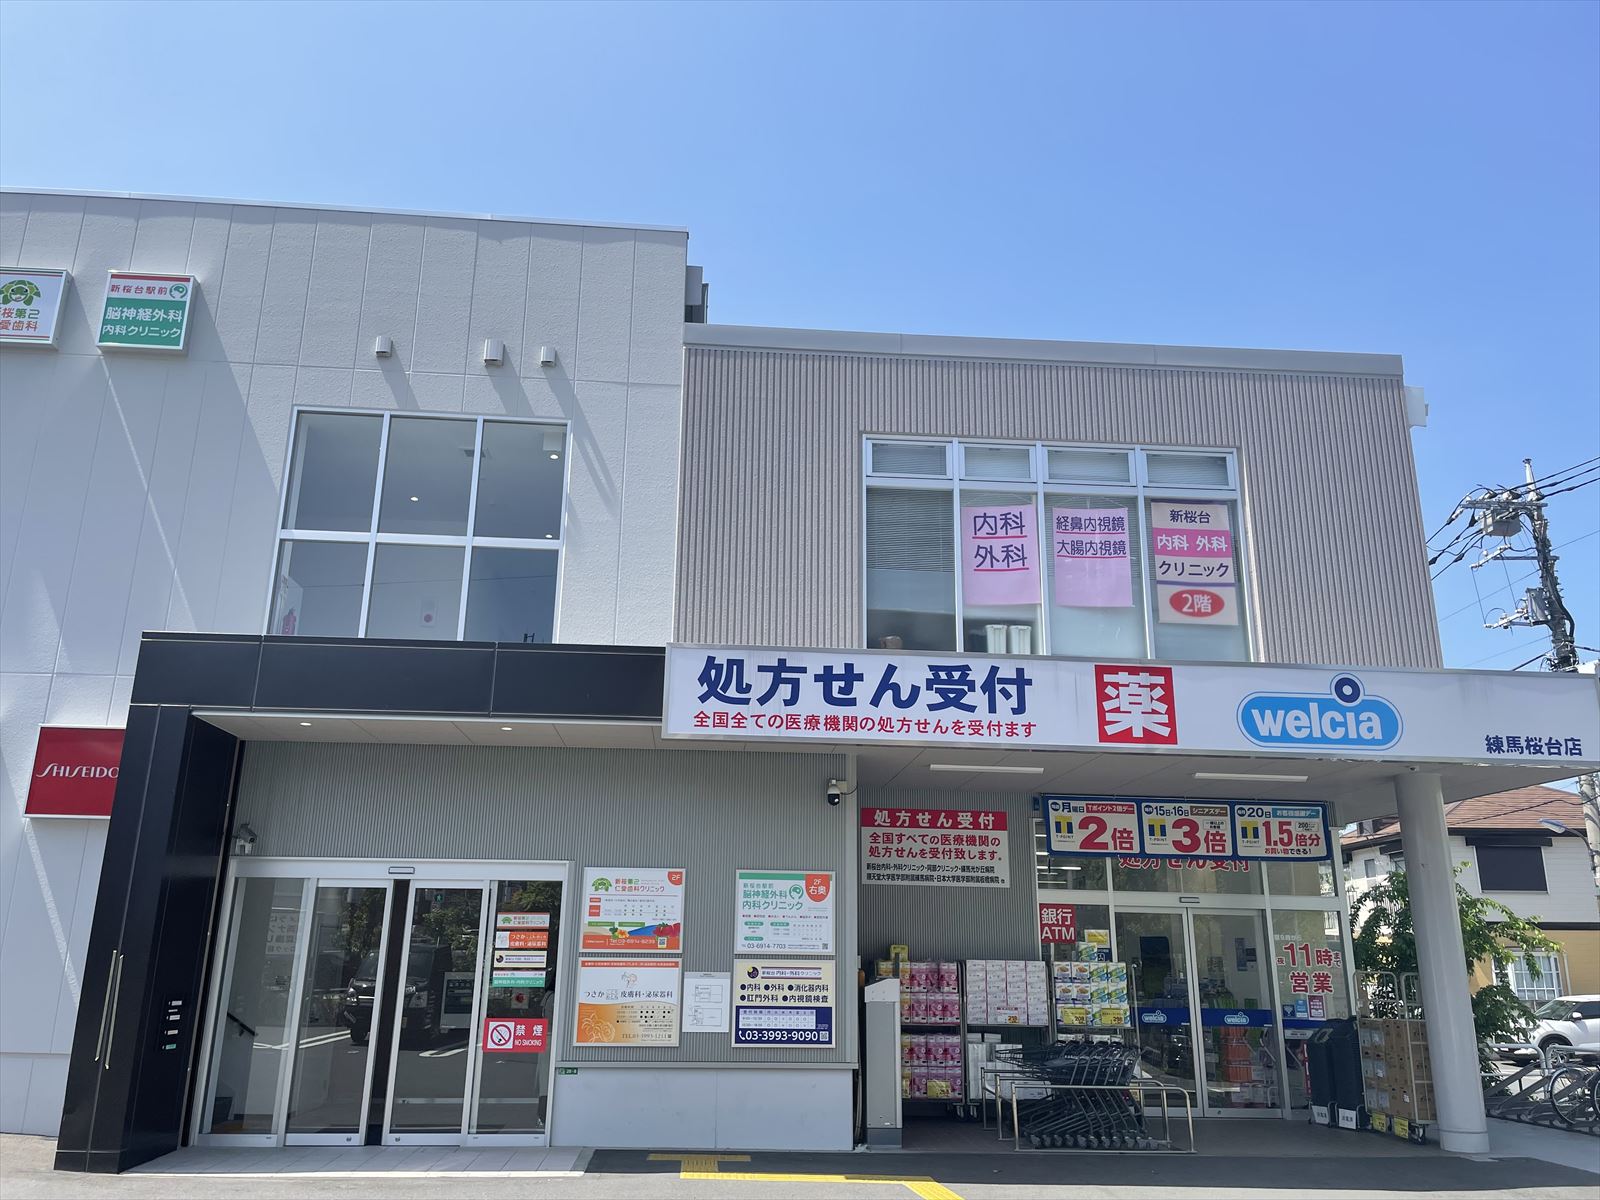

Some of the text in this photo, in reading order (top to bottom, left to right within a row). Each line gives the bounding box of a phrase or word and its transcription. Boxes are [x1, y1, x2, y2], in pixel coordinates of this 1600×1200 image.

[110, 284, 168, 296] 新桜台駅前
[0, 307, 40, 319] 桜第2
[105, 306, 183, 323] 脳神経外科
[102, 325, 181, 338] 内科クリニック
[973, 511, 1025, 536] 内科
[1056, 515, 1125, 532] 経鼻内視鏡
[1169, 508, 1211, 524] 新桜台
[1057, 539, 1126, 556] 大腸内視鏡
[1157, 534, 1227, 552] 内科 外科
[973, 543, 1027, 569] 外科
[1159, 560, 1229, 578] クリニック
[1181, 593, 1212, 613] 2階
[697, 655, 1033, 715] 処方せん受付
[1103, 670, 1172, 739] 薬
[693, 710, 1037, 738] 全国全ての医療機関の処方せんを受付ます
[1251, 699, 1383, 740] welcia
[1485, 734, 1583, 757] 練馬桜台店
[36, 763, 119, 778] SHISEIDO
[1061, 802, 1085, 813] 月曜日
[1247, 807, 1272, 818] 20日
[874, 810, 995, 829] 処方せん受付
[869, 832, 1001, 847] 全国すべての医療機関の
[1078, 816, 1134, 851] 2倍
[1172, 818, 1227, 853] 3倍
[868, 845, 1003, 861] 処方せんを受付致します。
[742, 900, 803, 910] 内科クリニック
[1041, 908, 1072, 925] 銀行
[1041, 926, 1075, 940] ATM
[1290, 972, 1333, 993] 営業
[515, 1025, 543, 1036] 禁煙
[745, 1030, 818, 1041] 03-3993-9090
